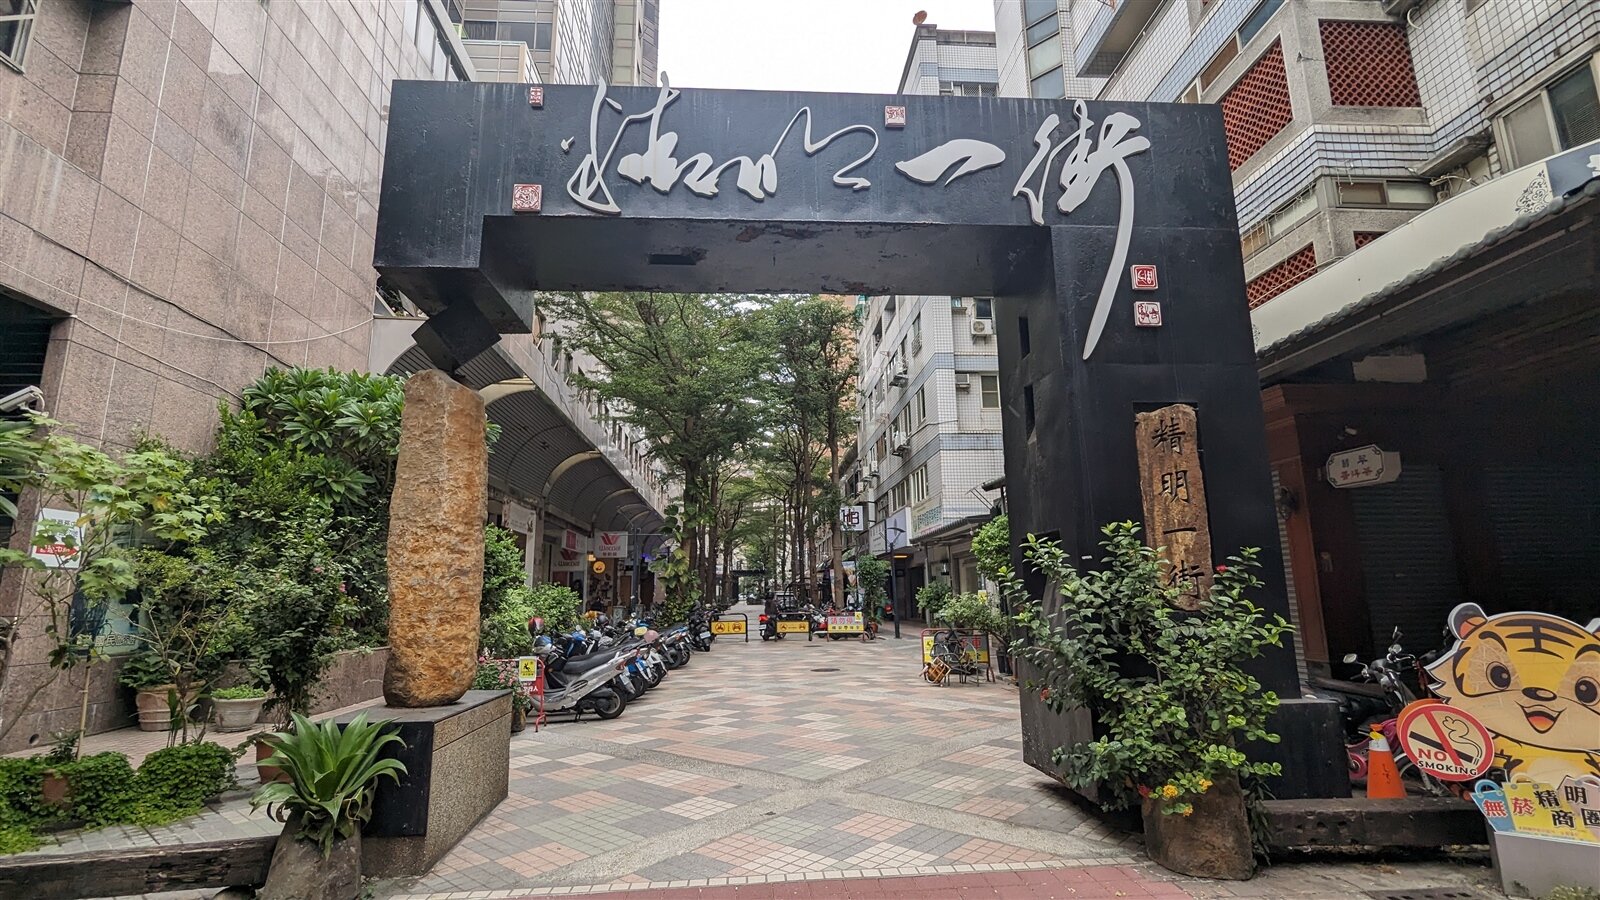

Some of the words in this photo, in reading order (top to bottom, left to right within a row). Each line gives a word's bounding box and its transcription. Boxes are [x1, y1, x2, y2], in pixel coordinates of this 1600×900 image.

[1151, 416, 1205, 599] 精明一街
[1417, 747, 1449, 763] NO
[1417, 758, 1478, 777] SMOKING
